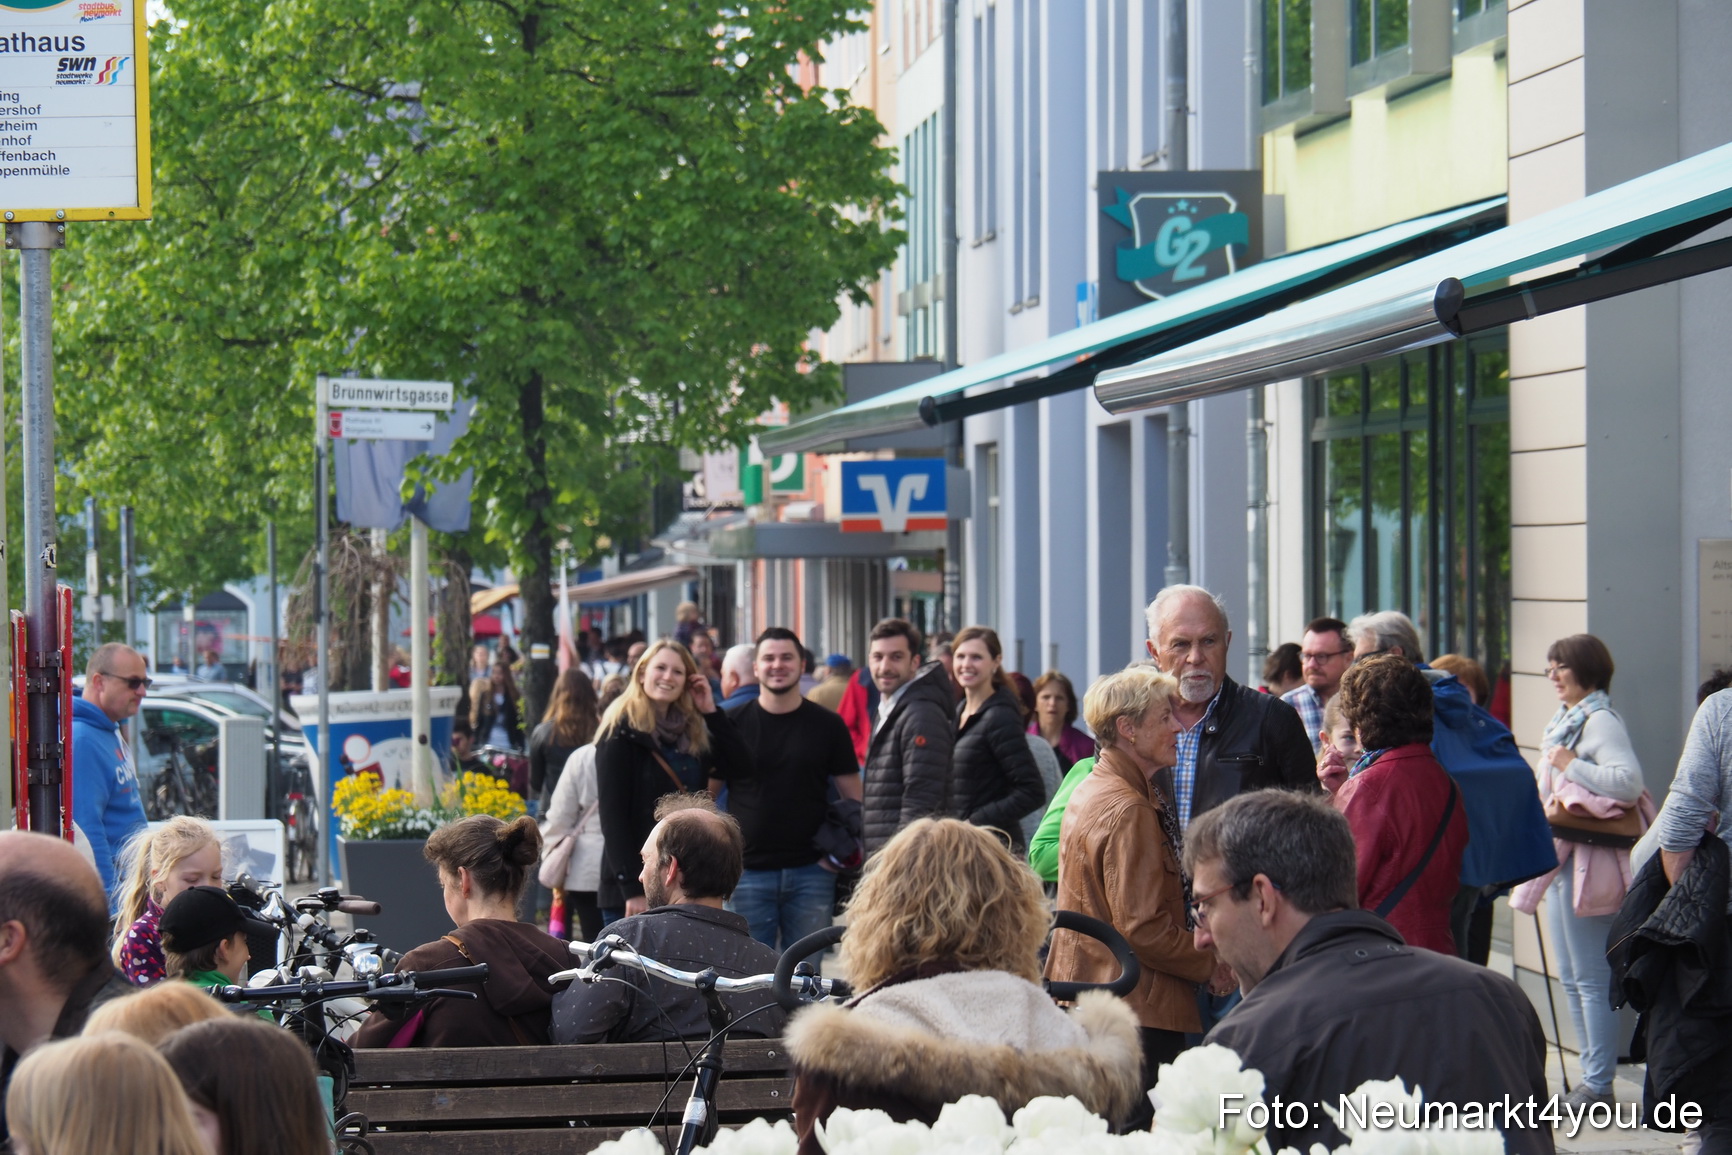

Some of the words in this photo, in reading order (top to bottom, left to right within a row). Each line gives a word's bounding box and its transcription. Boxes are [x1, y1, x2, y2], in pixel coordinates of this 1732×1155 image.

[78, 2, 115, 11] stadtbus
[83, 9, 122, 17] neumarkt
[57, 57, 97, 72] swn
[1155, 215, 1211, 282] G2
[332, 383, 449, 406] Brunnwirtsgasse
